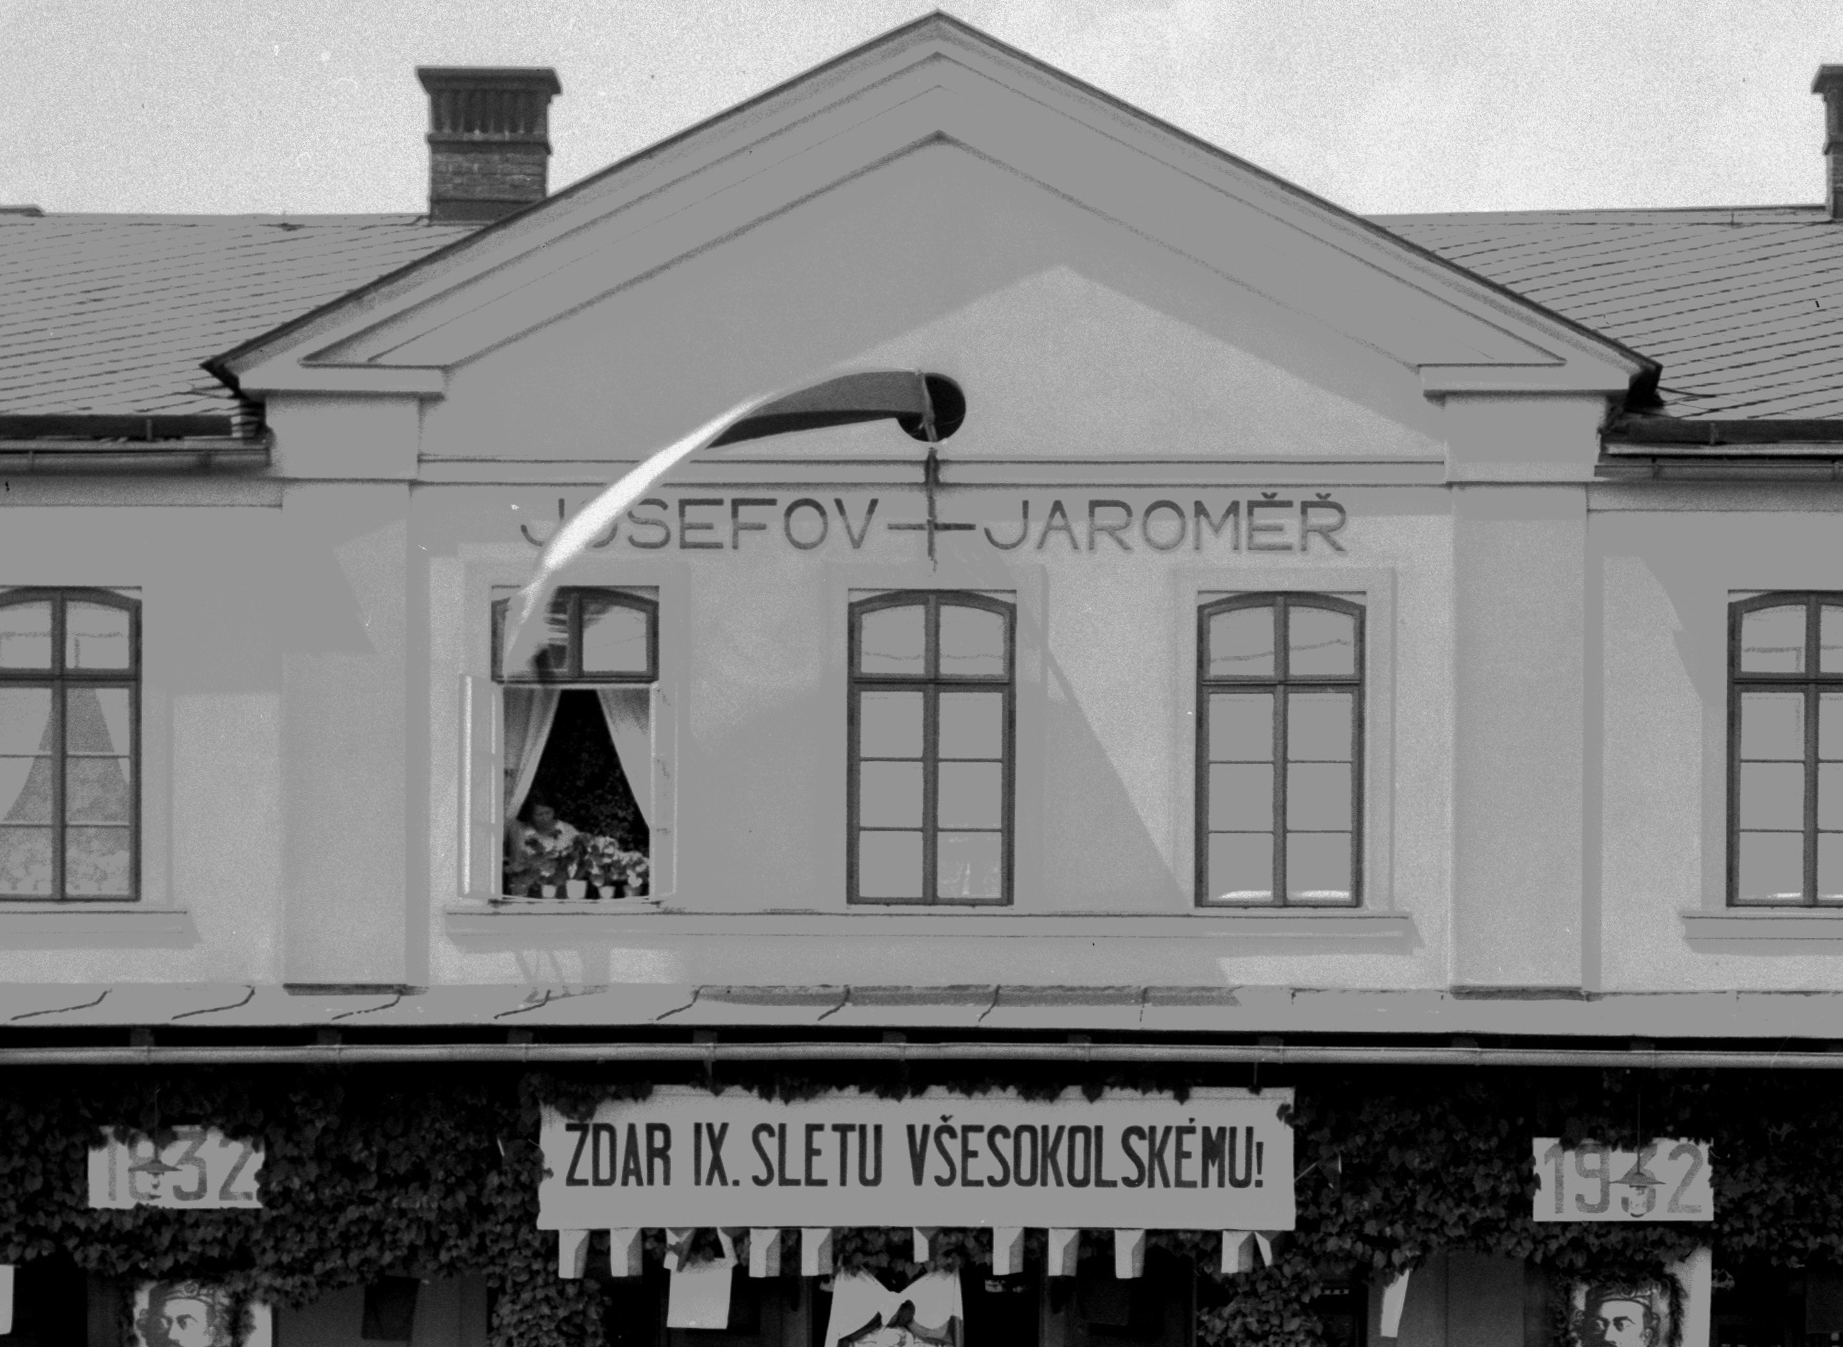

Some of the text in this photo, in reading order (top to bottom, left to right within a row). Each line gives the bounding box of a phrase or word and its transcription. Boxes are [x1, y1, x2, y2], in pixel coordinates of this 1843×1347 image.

[565, 1114, 1265, 1189] ZDAR IX. SLETU VŠESOKOLSKÉMU!
[1544, 1142, 1704, 1214] 1932
